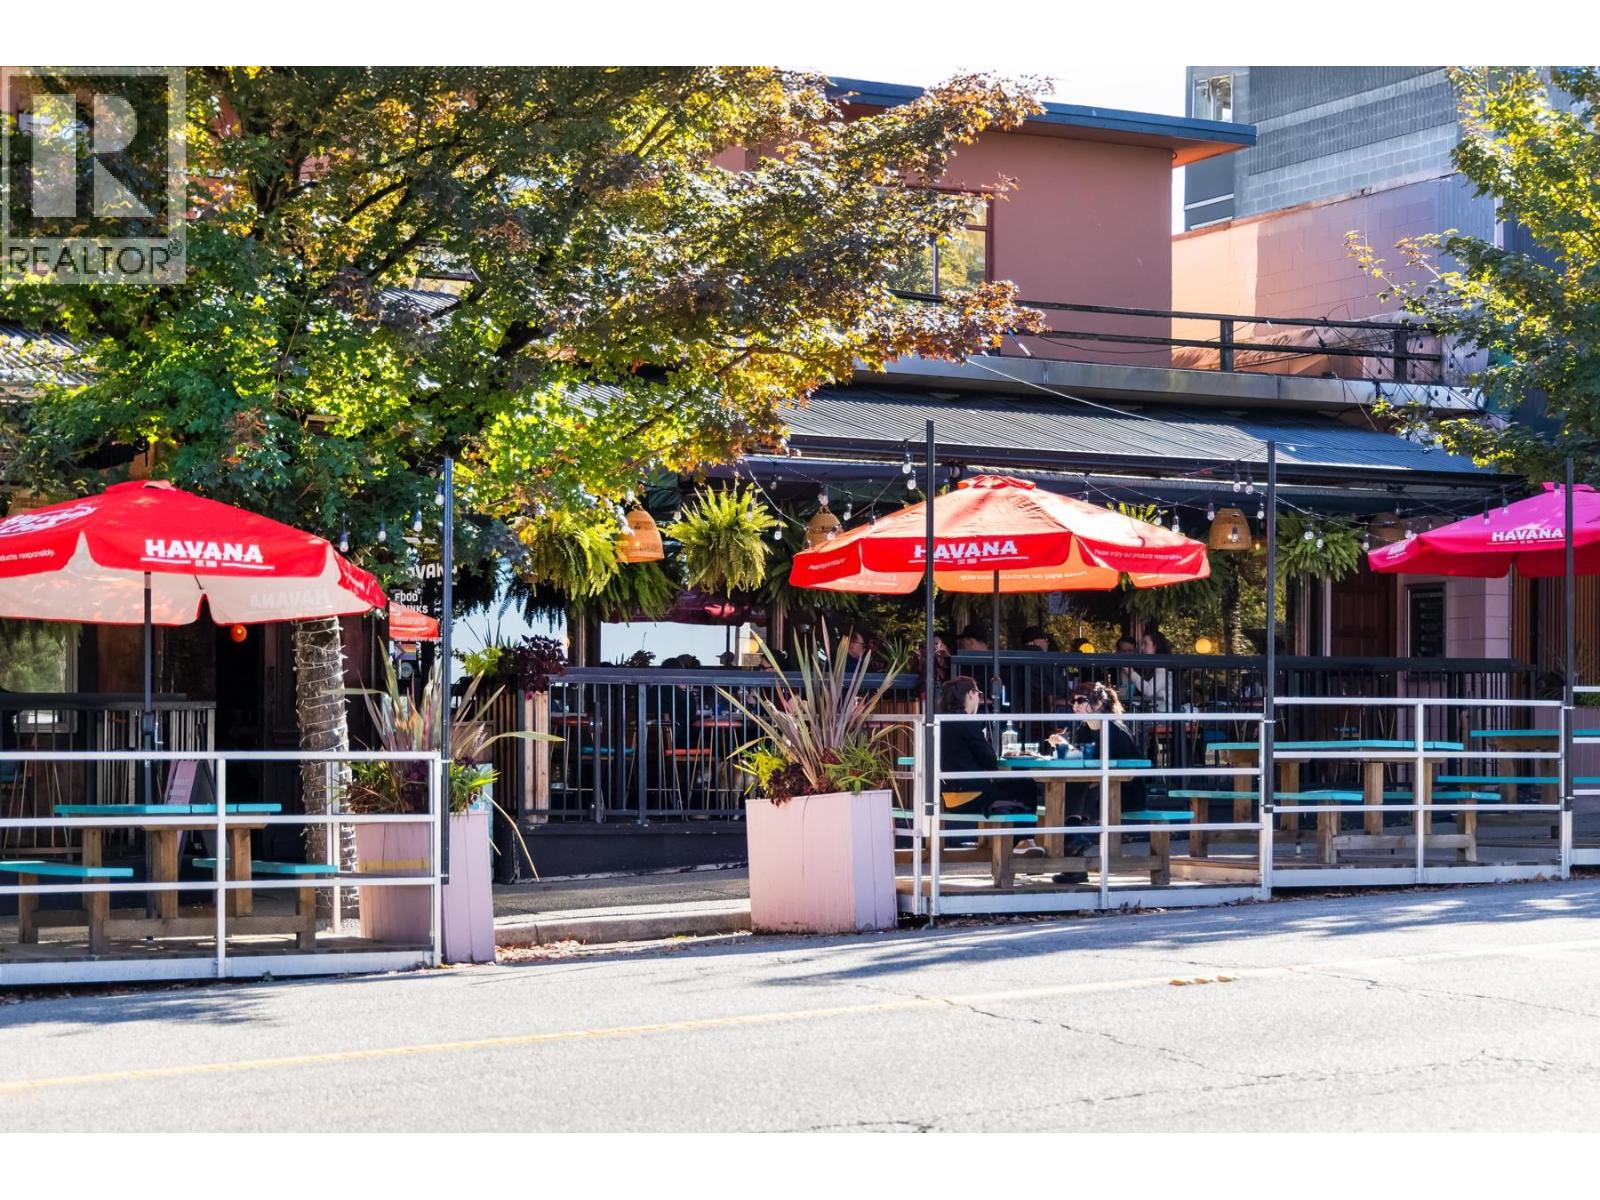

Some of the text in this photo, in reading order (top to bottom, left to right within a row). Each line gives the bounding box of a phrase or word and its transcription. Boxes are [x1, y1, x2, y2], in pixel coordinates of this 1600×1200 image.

[1491, 528, 1564, 542] HAVANA
[145, 539, 264, 563] HAVANA
[914, 540, 1018, 559] HAVANA
[394, 592, 419, 602] FOOD
